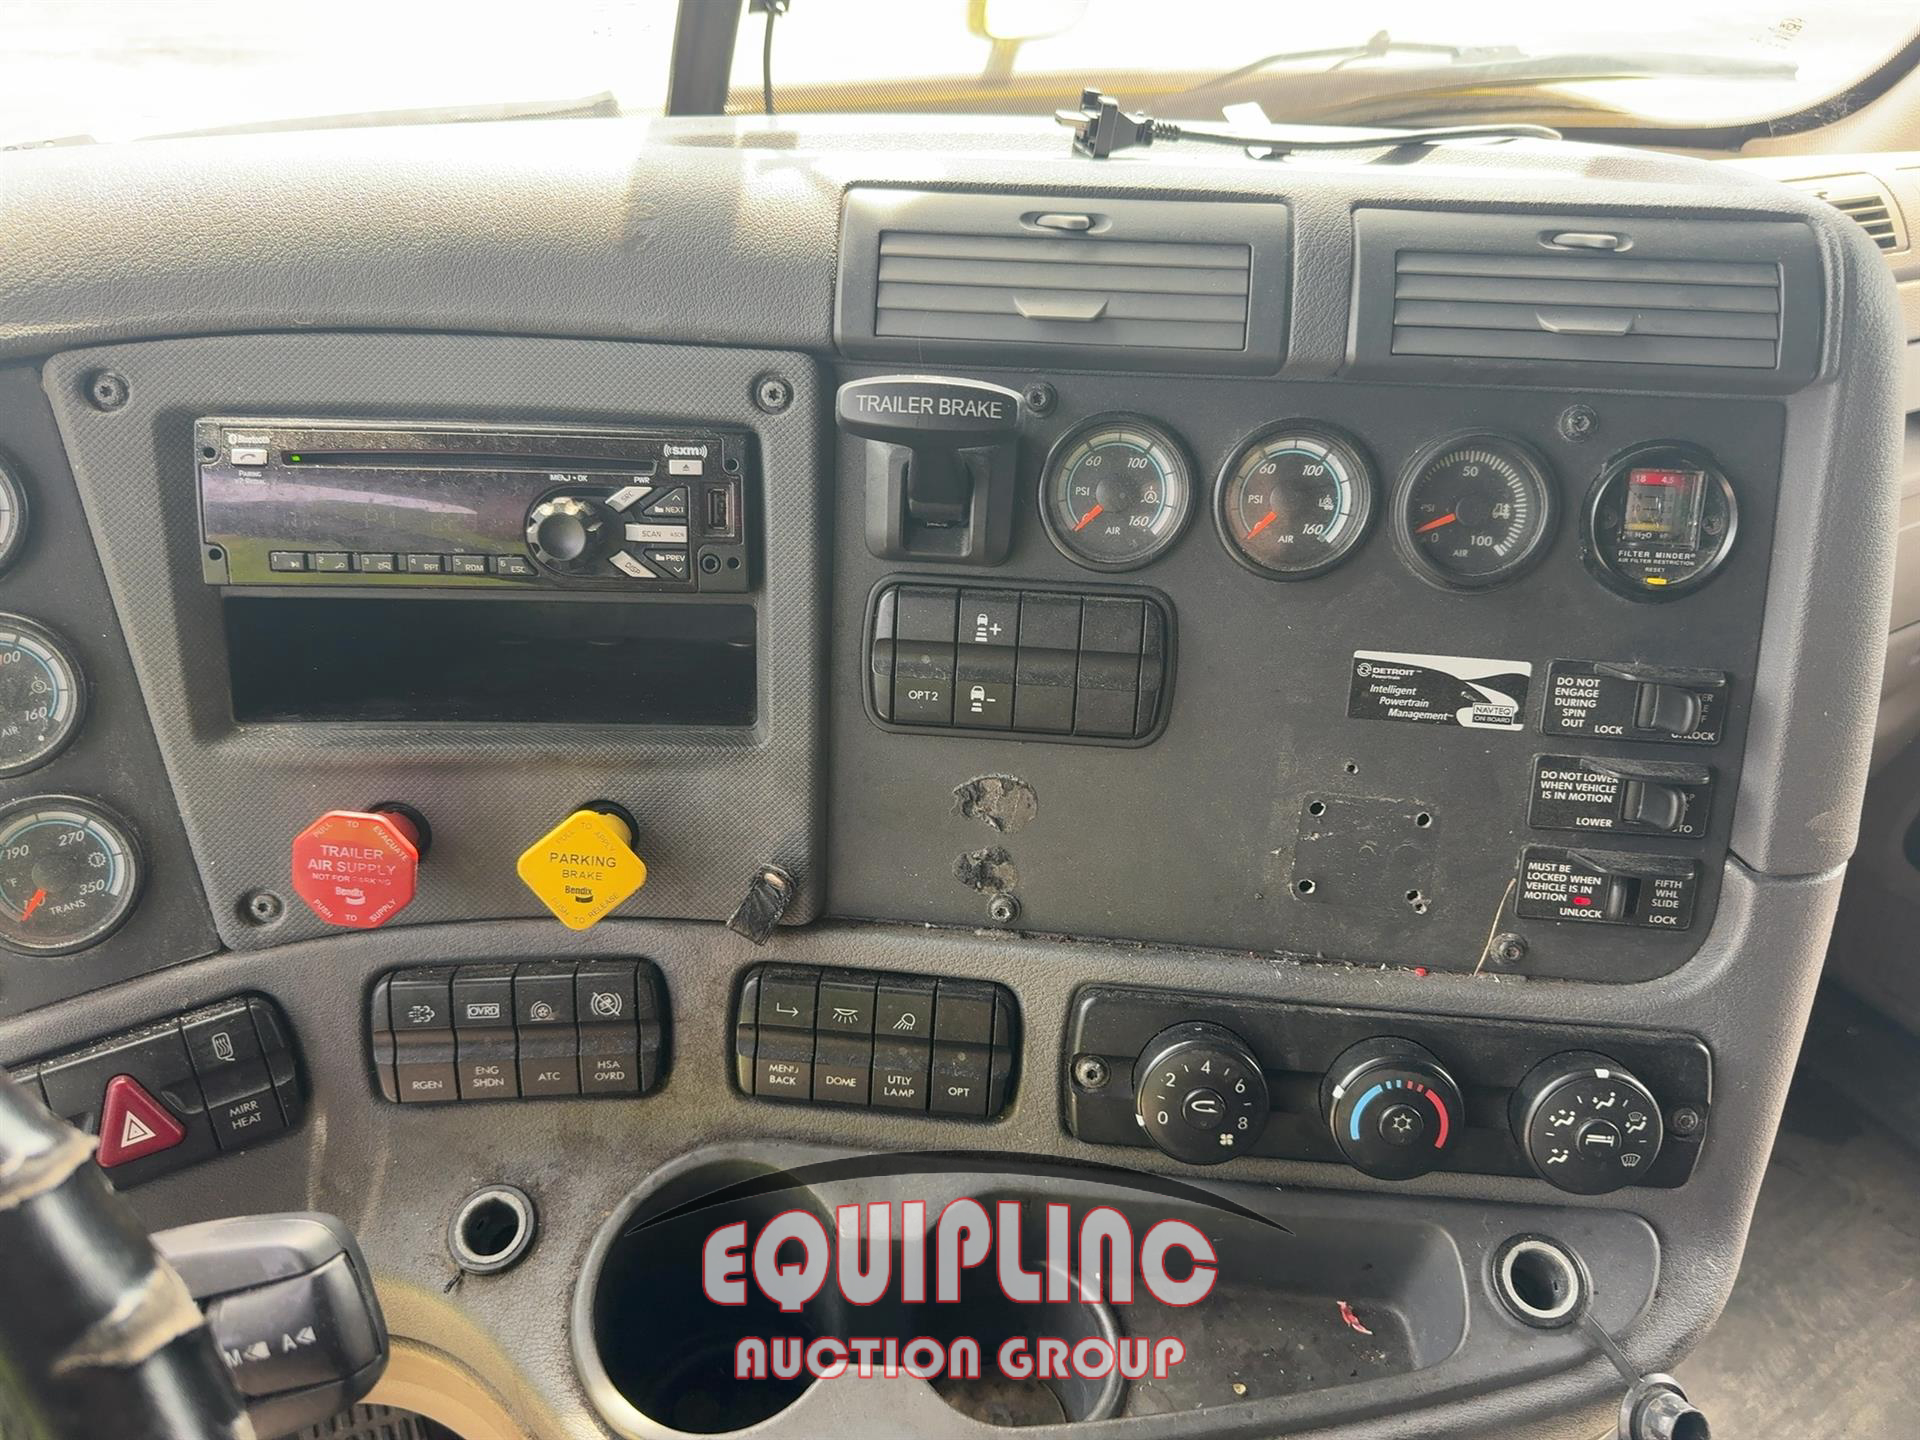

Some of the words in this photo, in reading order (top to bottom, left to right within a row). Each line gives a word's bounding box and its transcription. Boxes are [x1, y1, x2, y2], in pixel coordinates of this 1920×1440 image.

[856, 394, 933, 415] TRAILER
[939, 399, 1002, 419] BRAKE
[1085, 456, 1102, 467] 60
[1127, 457, 1149, 469] 100
[1259, 463, 1277, 475] 60
[1302, 464, 1324, 476] 100
[1462, 465, 1479, 477] 50
[633, 476, 650, 484] PWR
[1075, 486, 1090, 497] PSI
[1247, 494, 1264, 505] PSI
[665, 506, 685, 514] NEXT
[1128, 515, 1149, 527] 160
[641, 530, 662, 538] SCAN
[1104, 525, 1121, 536] AIR
[1302, 523, 1324, 535] 160
[1277, 534, 1294, 544] AIR
[1431, 531, 1440, 543] 0
[1470, 535, 1493, 547] 100
[665, 553, 686, 562] PREV
[1452, 549, 1469, 558] AIR
[1617, 550, 1650, 558] FILTER
[424, 563, 439, 571] RPT
[465, 564, 484, 572] RDM
[1653, 558, 1695, 566] RESTRICTION
[510, 565, 526, 574] ESC
[1372, 667, 1415, 676] DETROIT
[1557, 677, 1574, 687] DO
[1576, 678, 1601, 688] NOT
[908, 690, 930, 701] OPT
[931, 691, 939, 701] 2
[1370, 684, 1417, 697] Intelligent
[1555, 687, 1600, 698] ENGAGE
[1379, 696, 1429, 708] Powertrain
[1554, 697, 1597, 709] DURING
[24, 706, 48, 721] 160
[1388, 708, 1449, 720] Management
[1475, 706, 1511, 716] NAVTEQ
[1562, 708, 1586, 718] SPIN
[1561, 718, 1585, 728] OUT
[2, 726, 18, 738] AIR
[1594, 725, 1623, 735] LOCK
[1671, 731, 1715, 741] OCK
[1541, 770, 1558, 780] DO
[1559, 771, 1582, 781] NOT
[1583, 773, 1619, 784] LOWER
[1541, 780, 1573, 791] WHEN
[1576, 782, 1617, 794] VEHICLE
[1542, 790, 1551, 800] IS
[1554, 791, 1566, 801] IN
[1568, 792, 1613, 804] MOTION
[1576, 816, 1613, 828] LOWER
[58, 830, 85, 847] 270
[346, 820, 359, 829] TO
[372, 825, 409, 862] EVACUATE
[6, 844, 29, 860] 190
[320, 844, 384, 860] TRAILER
[549, 852, 617, 868] PARKING
[307, 858, 333, 872] AIR
[336, 861, 396, 876] SUPPLY
[1528, 862, 1557, 872] MUST
[1559, 864, 1572, 874] BE
[312, 872, 331, 881] NOT
[562, 869, 604, 881] BRAKE
[1527, 872, 1567, 883] LOCKED
[1570, 875, 1601, 886] WHEN
[79, 879, 105, 896] 350
[1526, 881, 1567, 893] VEHICLE
[1568, 884, 1578, 894] IS
[1580, 885, 1592, 895] IN
[1654, 879, 1683, 889] FIFTH
[564, 885, 592, 896] Bendix
[1524, 891, 1567, 902] MOTION
[1655, 889, 1679, 899] WHL
[49, 898, 86, 915] TRANS
[587, 891, 620, 918] RELEASE
[1651, 898, 1679, 909] SLIDE
[313, 898, 334, 919] PUSH
[344, 914, 358, 922] TO
[369, 898, 397, 923] SUPPLY
[1559, 907, 1602, 918] UNLOCK
[1648, 915, 1677, 925] LOCK
[469, 1006, 498, 1016] OVRD
[475, 1065, 500, 1076] ENG
[597, 1060, 621, 1069] HSA
[1201, 1060, 1211, 1075] 4
[538, 1071, 561, 1082] ATC
[594, 1071, 625, 1081] OVRD
[769, 1075, 797, 1086] BACK
[826, 1075, 857, 1087] DOME
[887, 1075, 912, 1086] UTLY
[1165, 1072, 1176, 1088] 2
[412, 1080, 443, 1090] RGEN
[473, 1077, 504, 1088] SHDN
[1235, 1078, 1246, 1093] 6
[884, 1087, 915, 1098] LAMP
[948, 1086, 970, 1098] OPT
[229, 1099, 259, 1117] MIRR
[231, 1111, 262, 1130] HEAT
[1157, 1111, 1169, 1125] 0
[1237, 1116, 1248, 1130] 8
[222, 1348, 244, 1370] M
[282, 1333, 298, 1354] A
